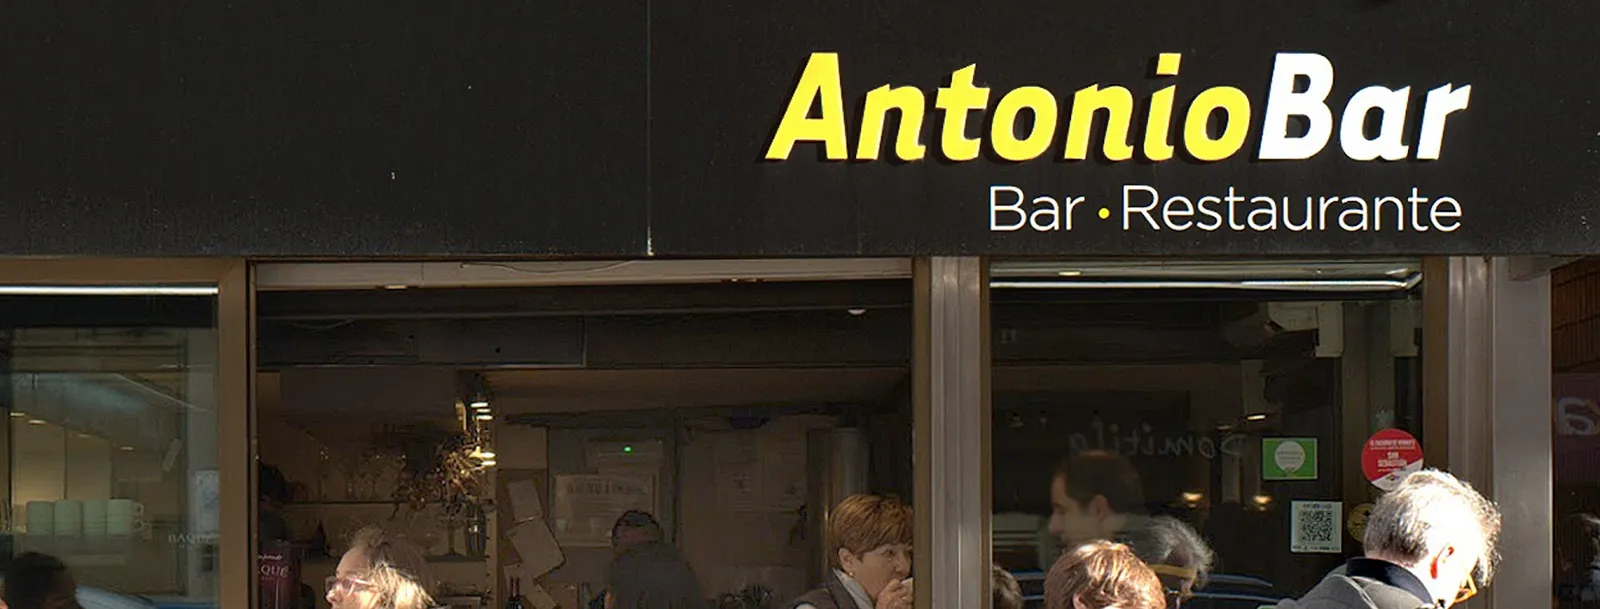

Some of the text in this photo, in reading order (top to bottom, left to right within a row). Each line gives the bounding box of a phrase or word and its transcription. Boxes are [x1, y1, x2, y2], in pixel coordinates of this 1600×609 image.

[765, 52, 1472, 162] AntonioBar
[989, 184, 1463, 232] Bar Restaurante
